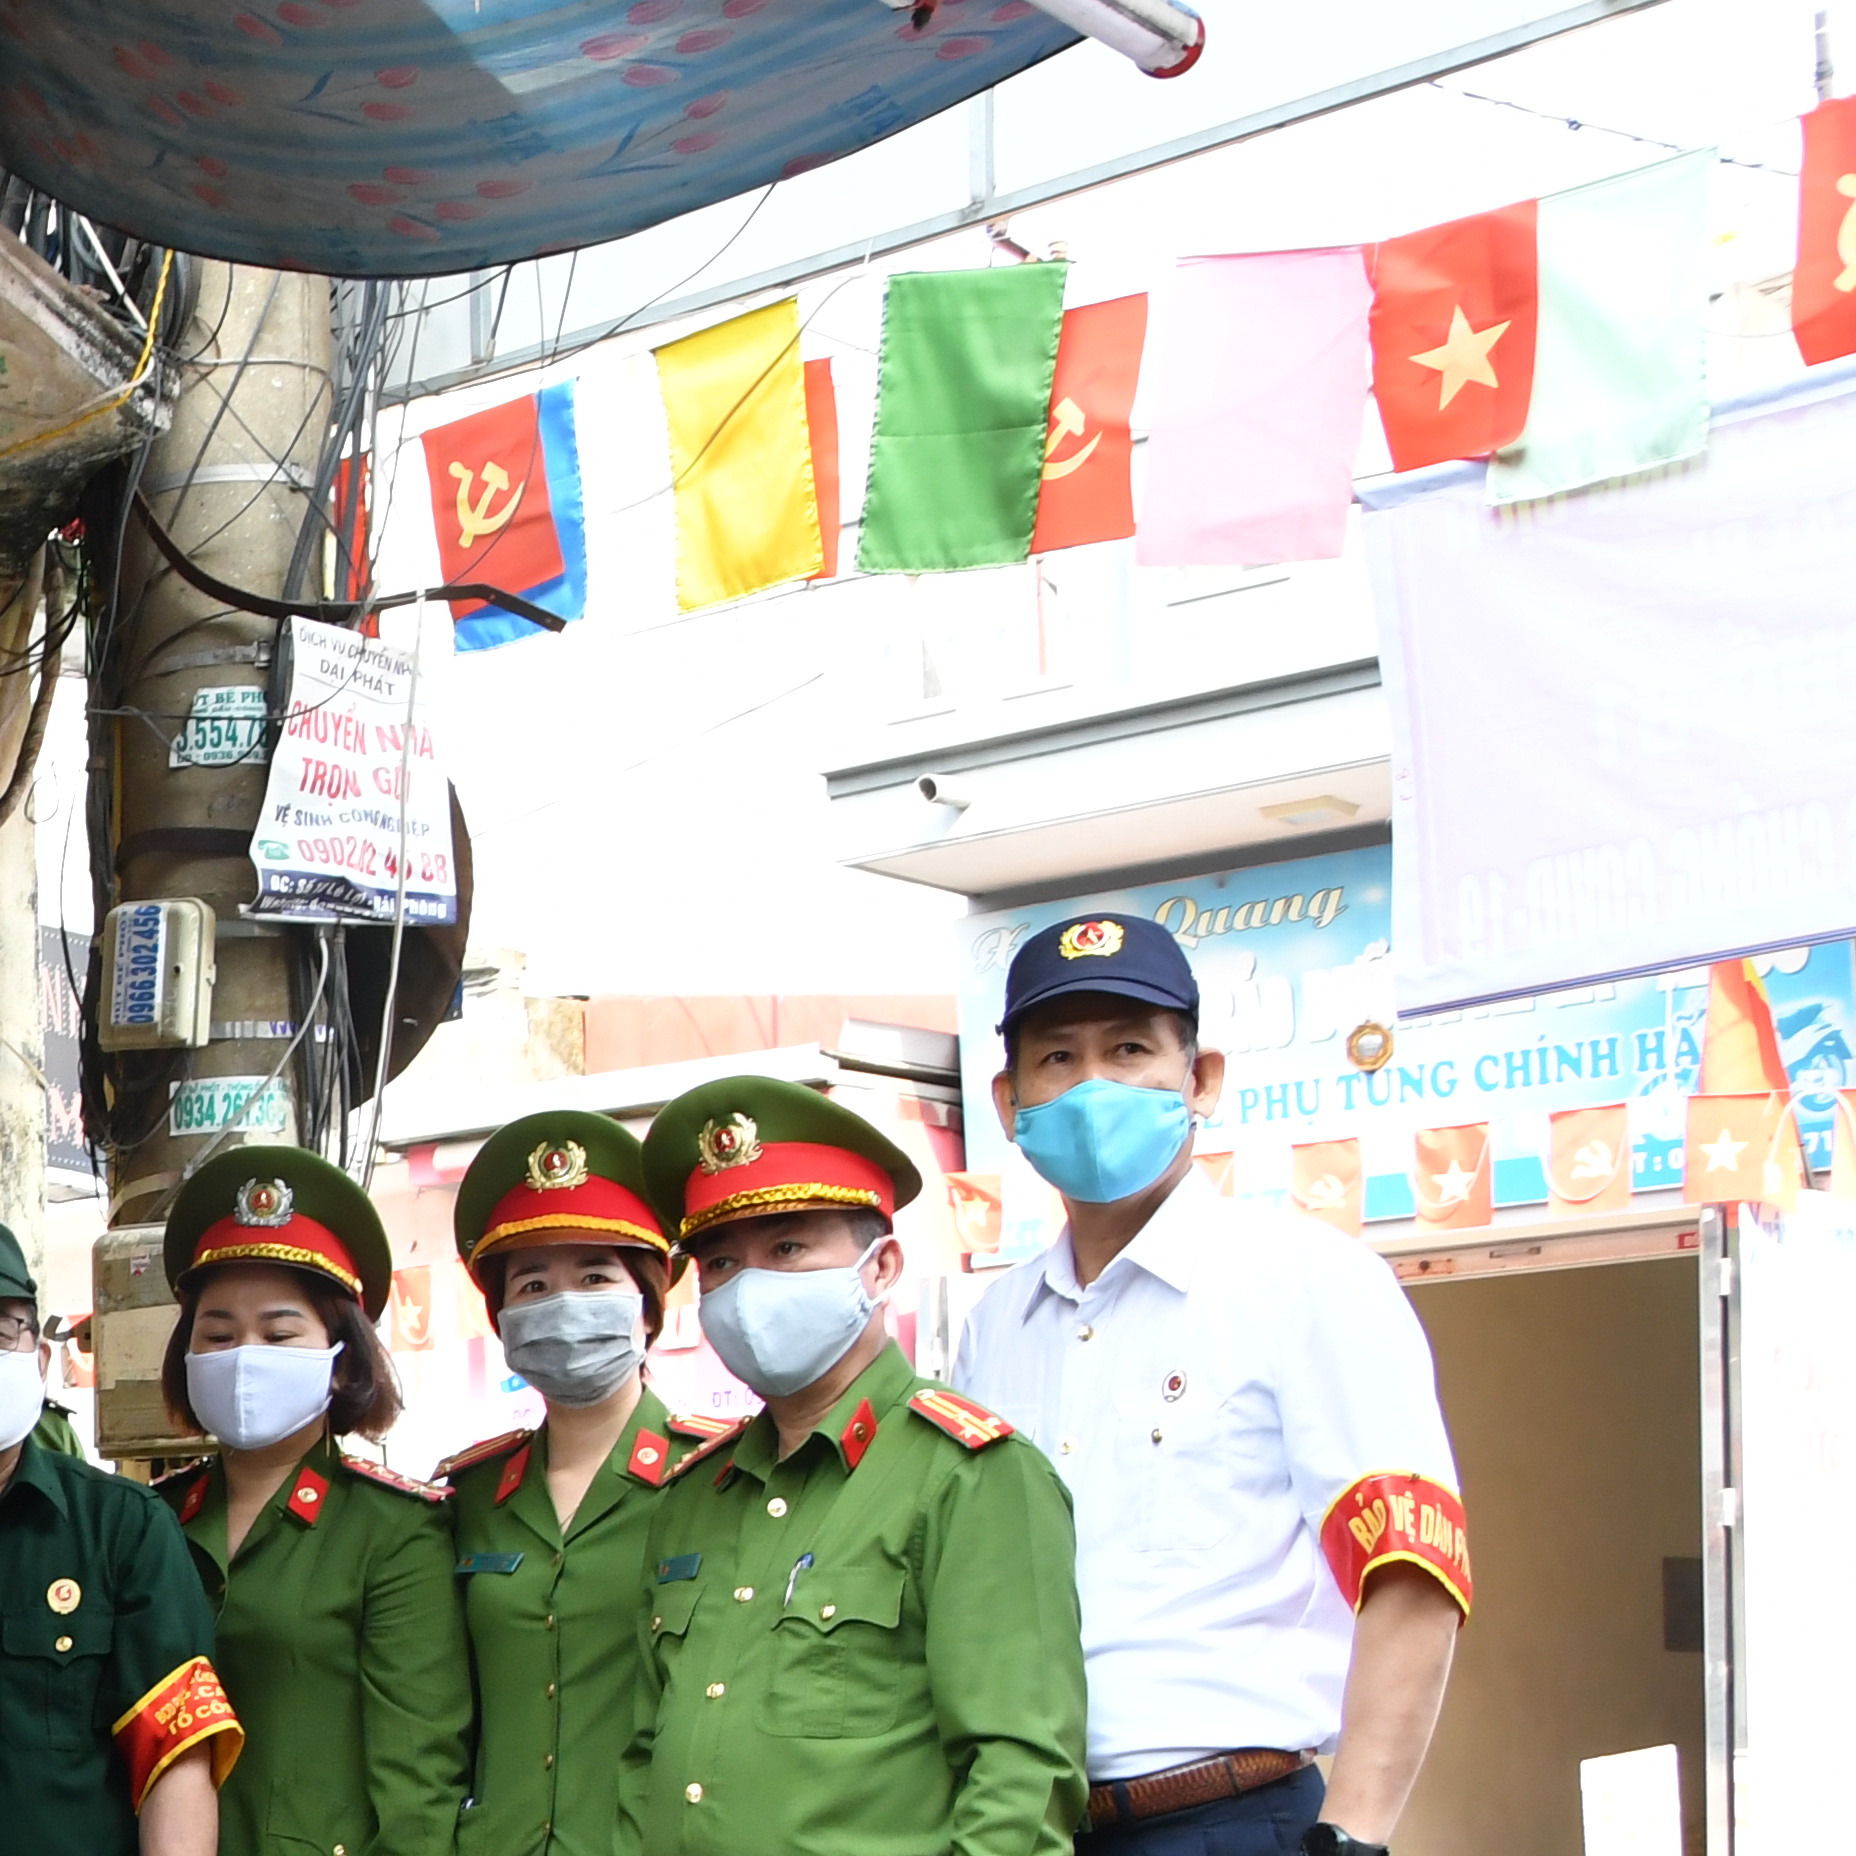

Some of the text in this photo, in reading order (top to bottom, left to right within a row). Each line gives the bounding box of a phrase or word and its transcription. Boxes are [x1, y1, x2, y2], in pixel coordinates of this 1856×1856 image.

[287, 700, 367, 755] CHUYỂN
[299, 757, 362, 807] TRỌN
[1154, 885, 1349, 949] Quang
[127, 905, 162, 1024] 0966 302 456
[1239, 1077, 1321, 1127] PHỤ
[1474, 1033, 1619, 1092] CHÍNH
[1634, 1007, 1701, 1072] HÃ
[1348, 1491, 1387, 1554] BẢO
[1389, 1490, 1417, 1544] VỆ
